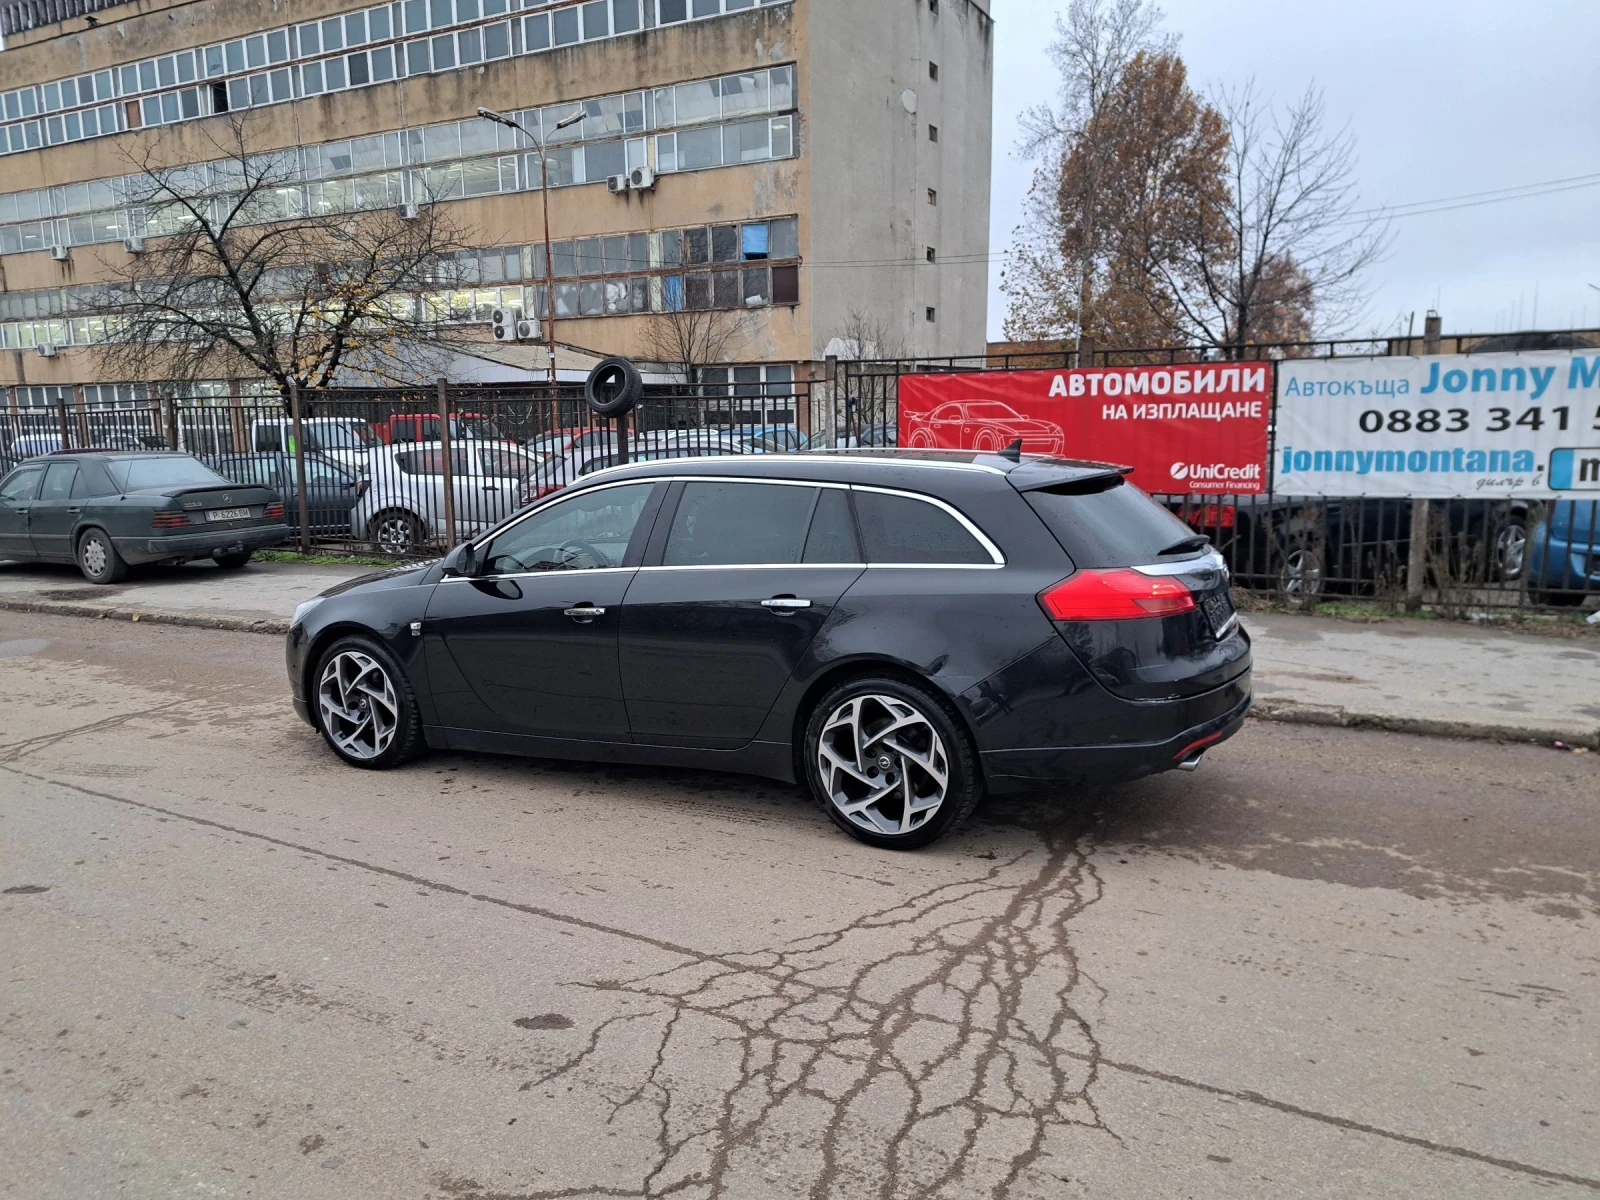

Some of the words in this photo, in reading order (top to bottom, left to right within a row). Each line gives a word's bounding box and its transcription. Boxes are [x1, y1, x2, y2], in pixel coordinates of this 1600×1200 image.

[1048, 367, 1265, 397] АВТОМОБИЛИ
[1285, 377, 1410, 398] Автокъща
[1420, 362, 1556, 400] Jonny
[1102, 404, 1128, 420] НА
[1133, 401, 1263, 422] ИЗПЛАЩАНЕ
[1359, 408, 1470, 434] 0883
[1486, 405, 1570, 432] 341
[1189, 463, 1260, 479] UniCredit
[1189, 480, 1224, 489] Consumer
[1226, 480, 1260, 491] Financing
